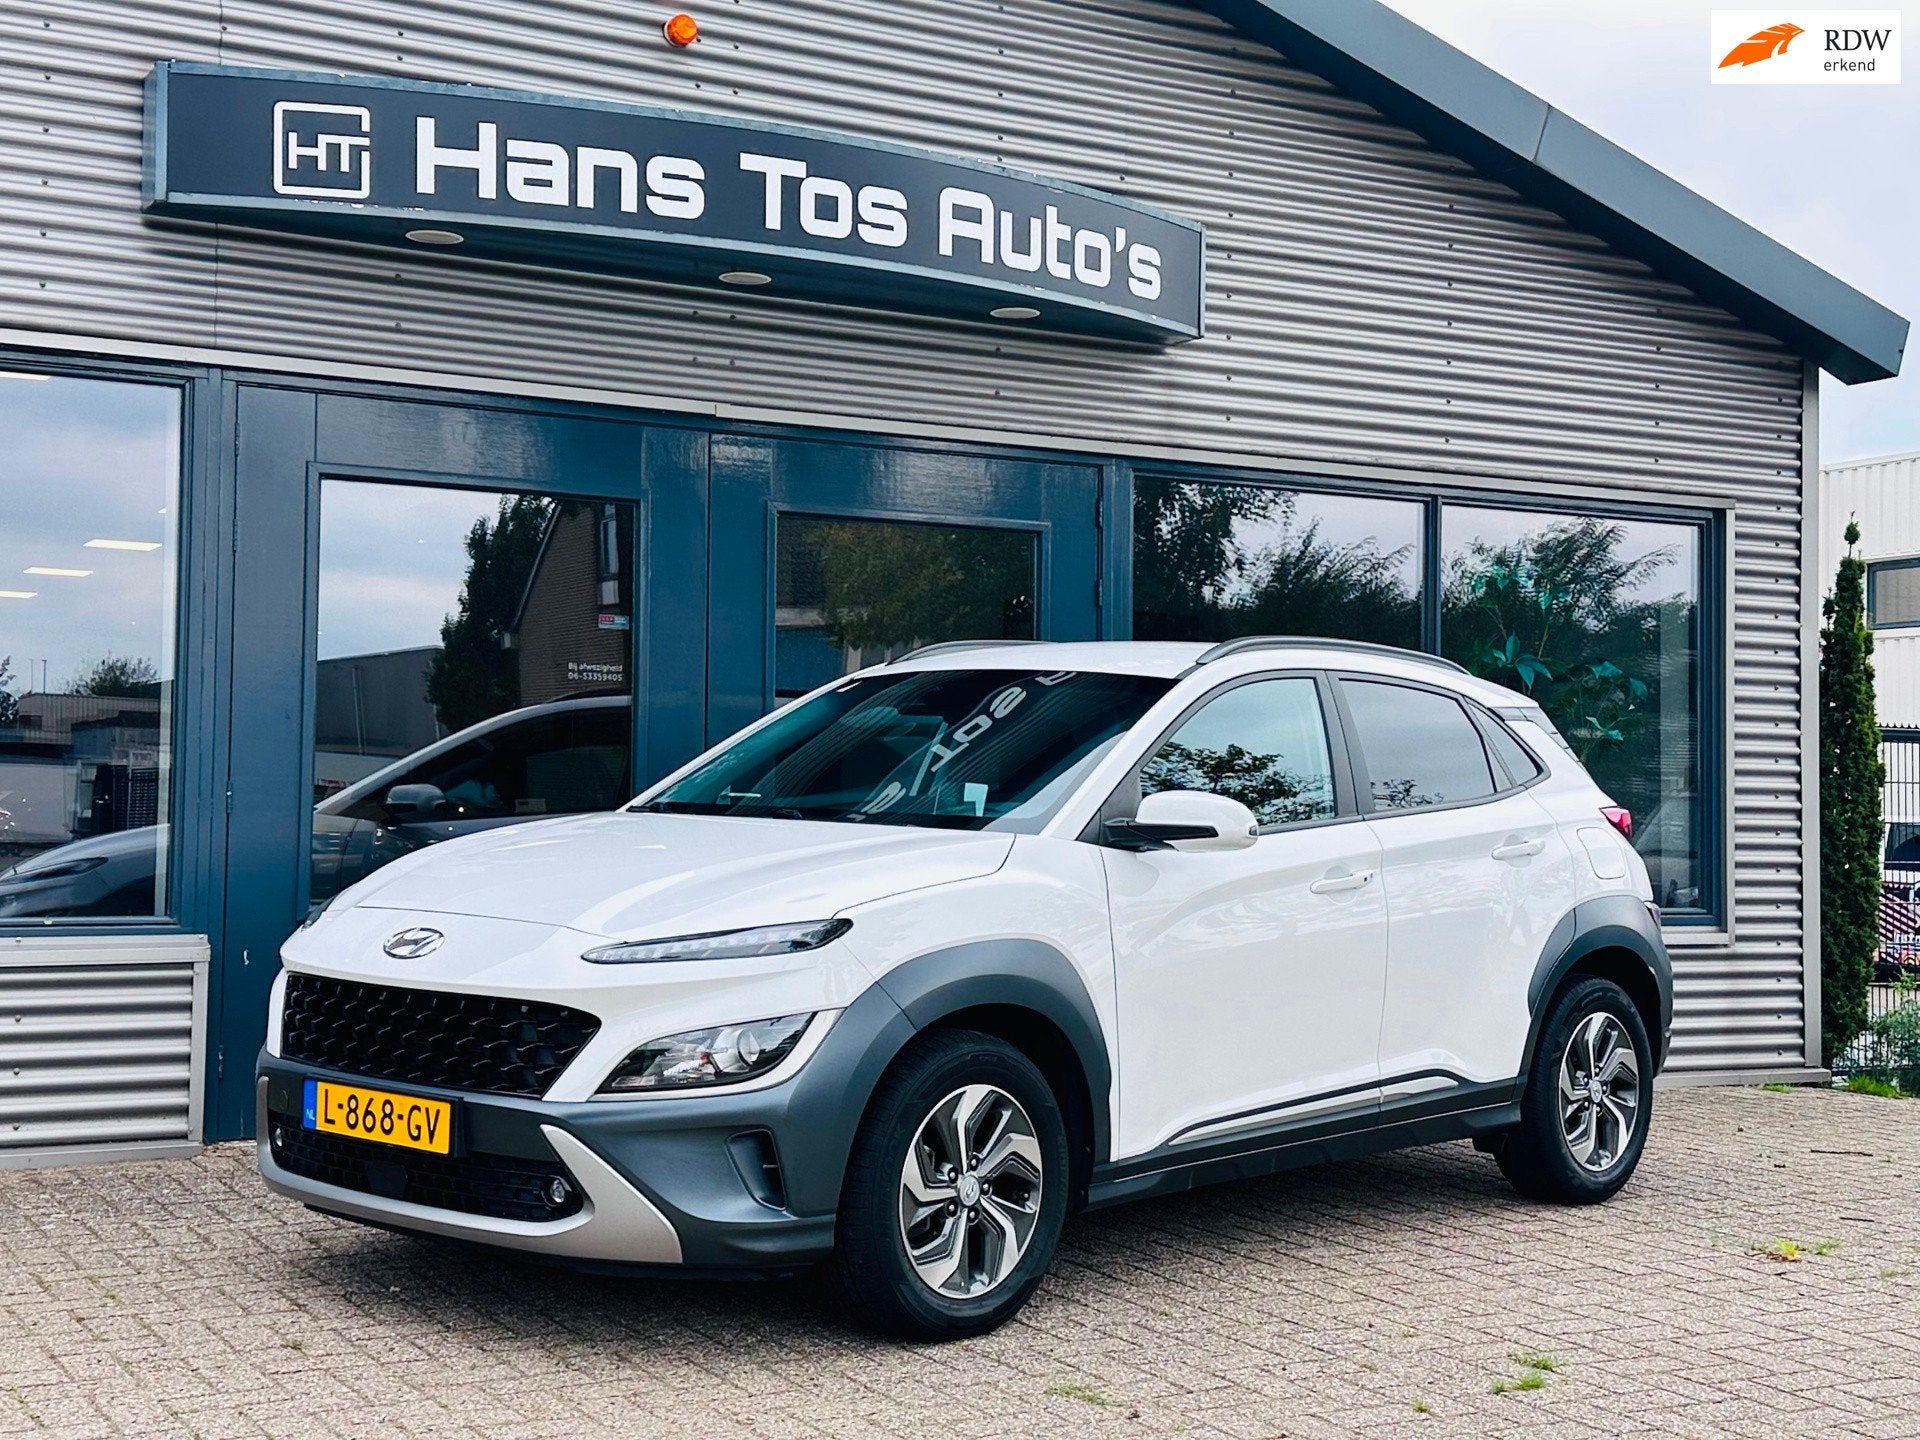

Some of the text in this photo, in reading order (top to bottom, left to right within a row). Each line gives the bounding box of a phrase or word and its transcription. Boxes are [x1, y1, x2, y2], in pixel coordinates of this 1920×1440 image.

[416, 116, 1163, 301] Hans Tos Auto's
[323, 1088, 441, 1145] L-868-GV
